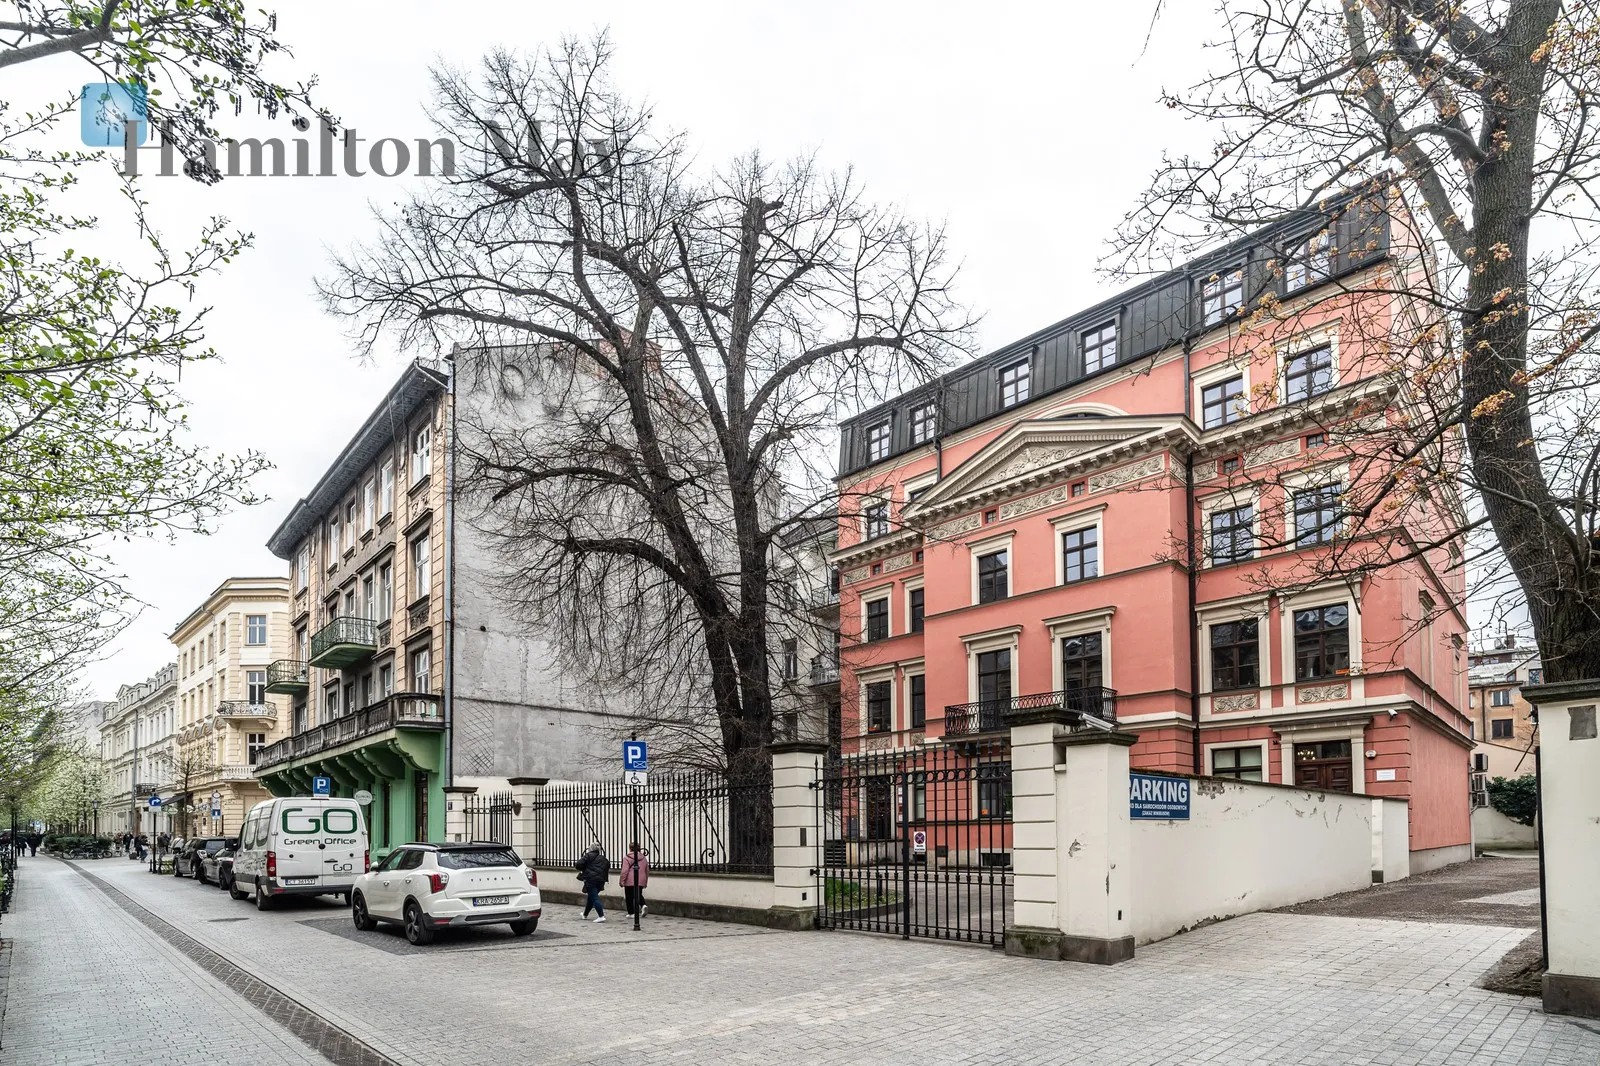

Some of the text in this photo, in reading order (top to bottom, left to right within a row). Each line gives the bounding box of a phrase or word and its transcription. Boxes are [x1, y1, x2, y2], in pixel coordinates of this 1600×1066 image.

[627, 745, 641, 764] P
[316, 778, 326, 789] P
[1130, 778, 1187, 803] ARKING
[282, 808, 357, 834] GO
[284, 837, 357, 846] Green Office
[333, 863, 353, 872] GO
